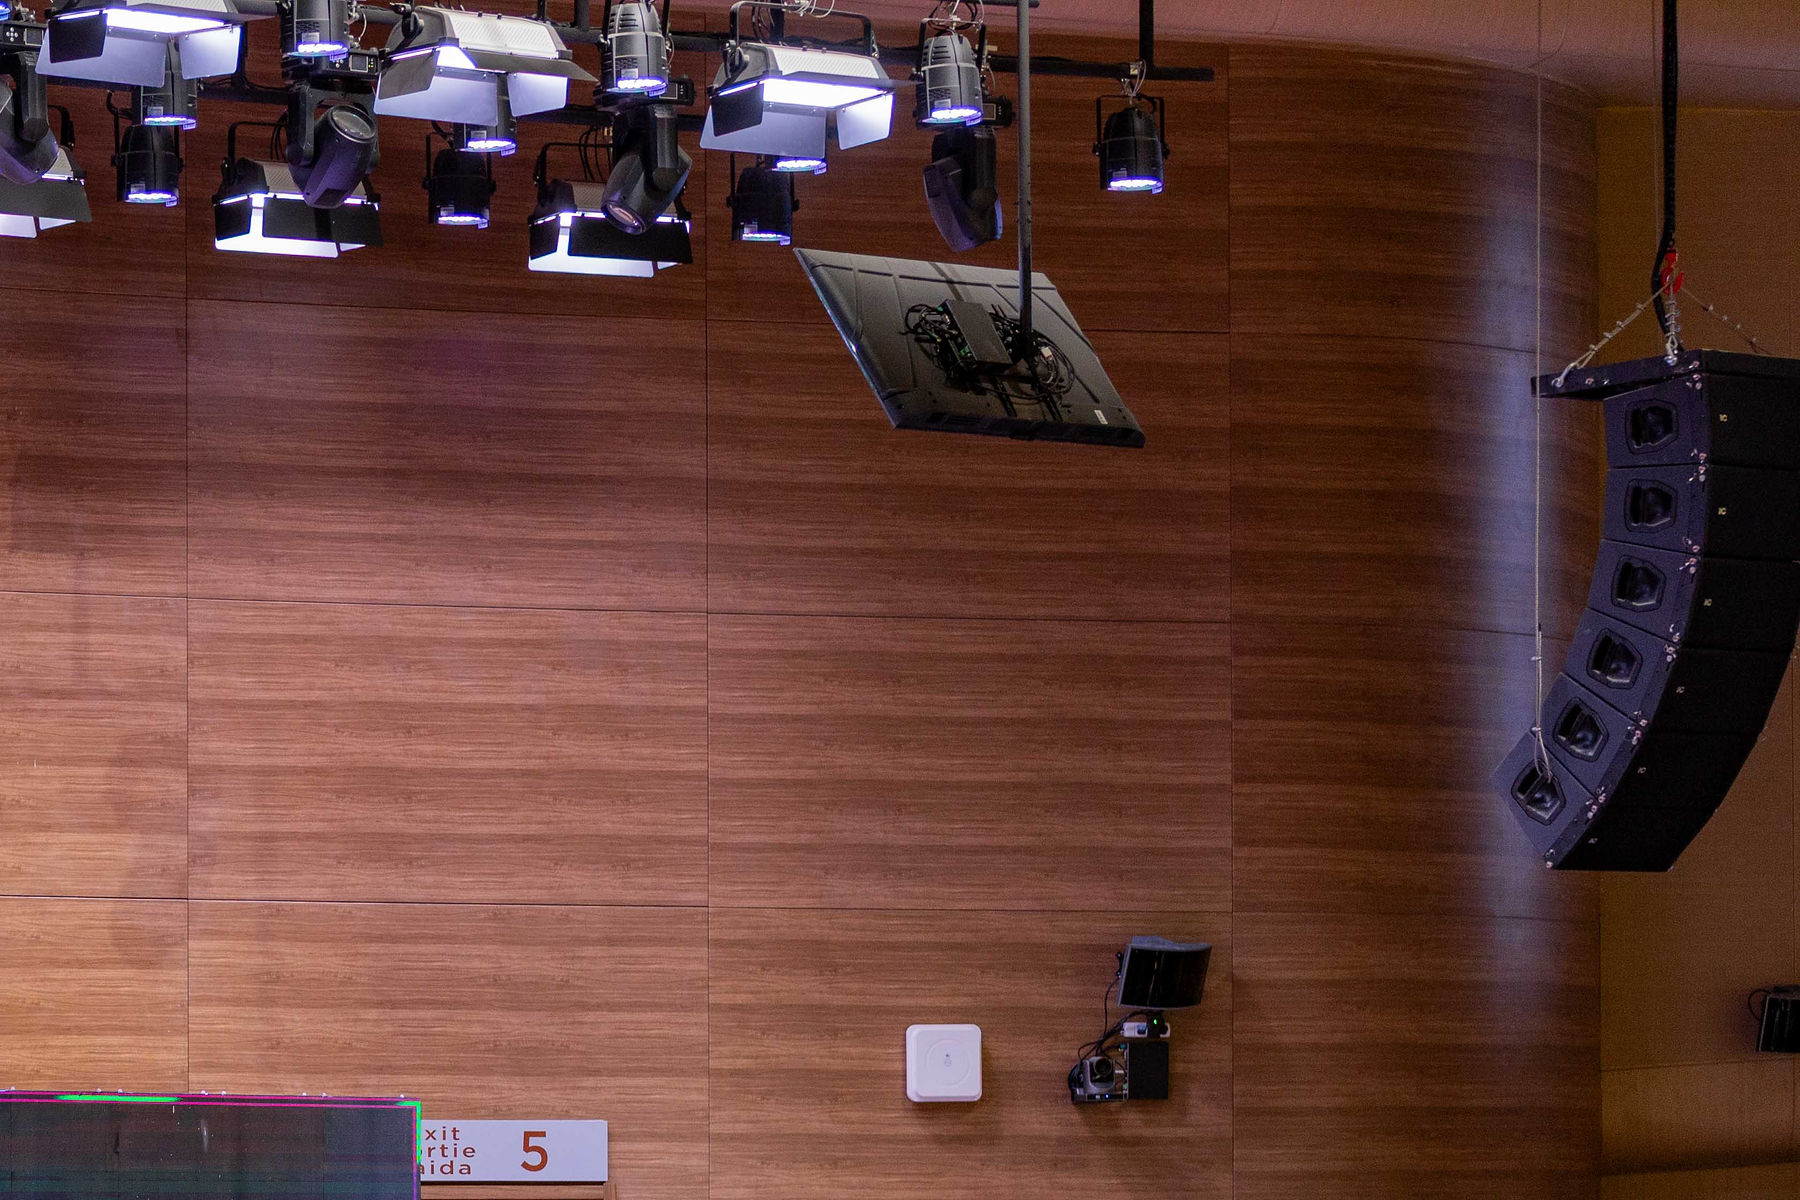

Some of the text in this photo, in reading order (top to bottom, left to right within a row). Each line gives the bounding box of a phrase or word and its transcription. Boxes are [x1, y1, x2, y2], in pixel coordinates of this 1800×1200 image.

[425, 1126, 460, 1141] xit
[420, 1144, 476, 1158] rtie
[520, 1130, 548, 1172] 5
